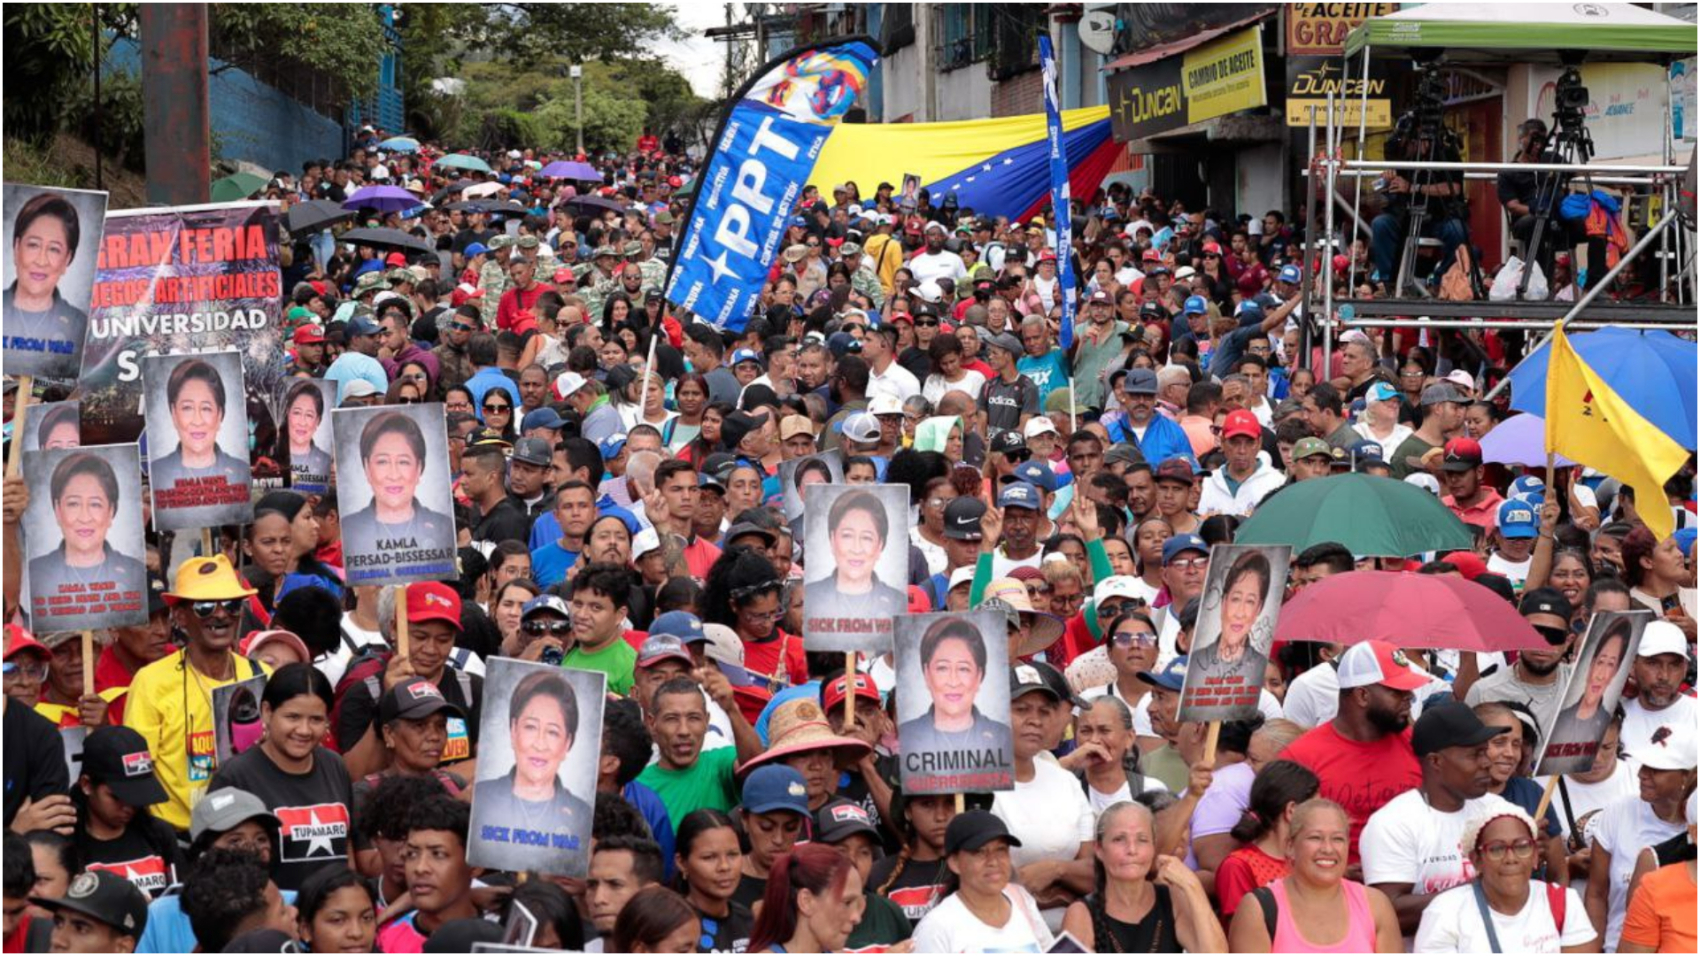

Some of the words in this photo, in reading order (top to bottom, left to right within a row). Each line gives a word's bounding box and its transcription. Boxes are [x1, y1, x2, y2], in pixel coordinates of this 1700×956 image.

[1188, 62, 1219, 90] CAMBIO
[1218, 59, 1230, 78] DE
[714, 115, 800, 260] PPT
[180, 224, 267, 265] FERIA
[155, 271, 279, 304] ARTIFICIALES
[91, 309, 267, 339] UNIVERSIDAD
[376, 536, 418, 551] KAMLA
[346, 547, 454, 567] PERSAD-BISSESSAR
[808, 617, 835, 633] SICK
[837, 617, 873, 633] FROM
[906, 748, 1010, 772] CRIMINAL
[293, 824, 345, 838] TUPAMARO
[481, 825, 511, 842] SICK
[512, 828, 549, 847] FROM
[551, 833, 580, 850] WAR
